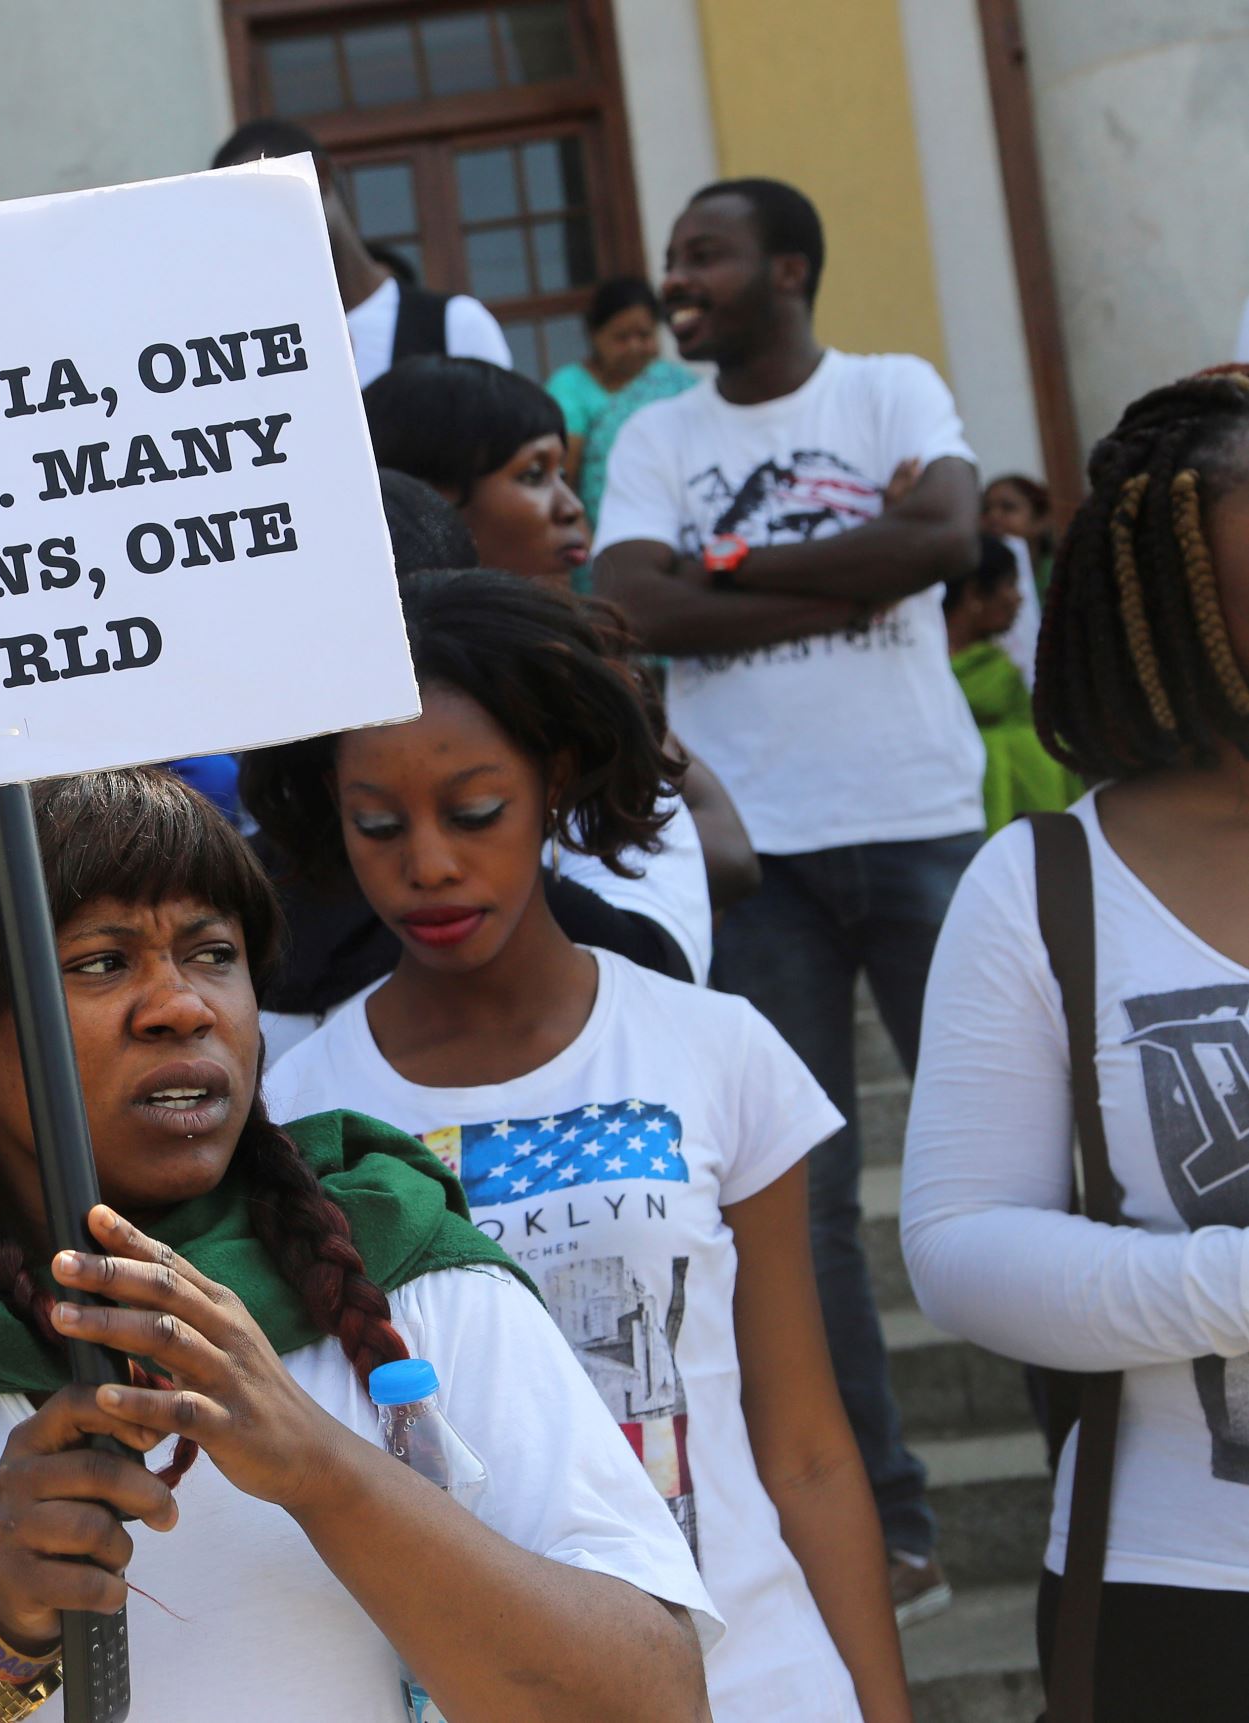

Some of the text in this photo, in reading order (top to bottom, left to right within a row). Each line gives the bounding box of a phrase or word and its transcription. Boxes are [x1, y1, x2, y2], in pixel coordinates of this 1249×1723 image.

[138, 323, 308, 393] ONE
[33, 413, 291, 501] MANY
[126, 503, 298, 574] ONE
[512, 1240, 579, 1262] TCHEN
